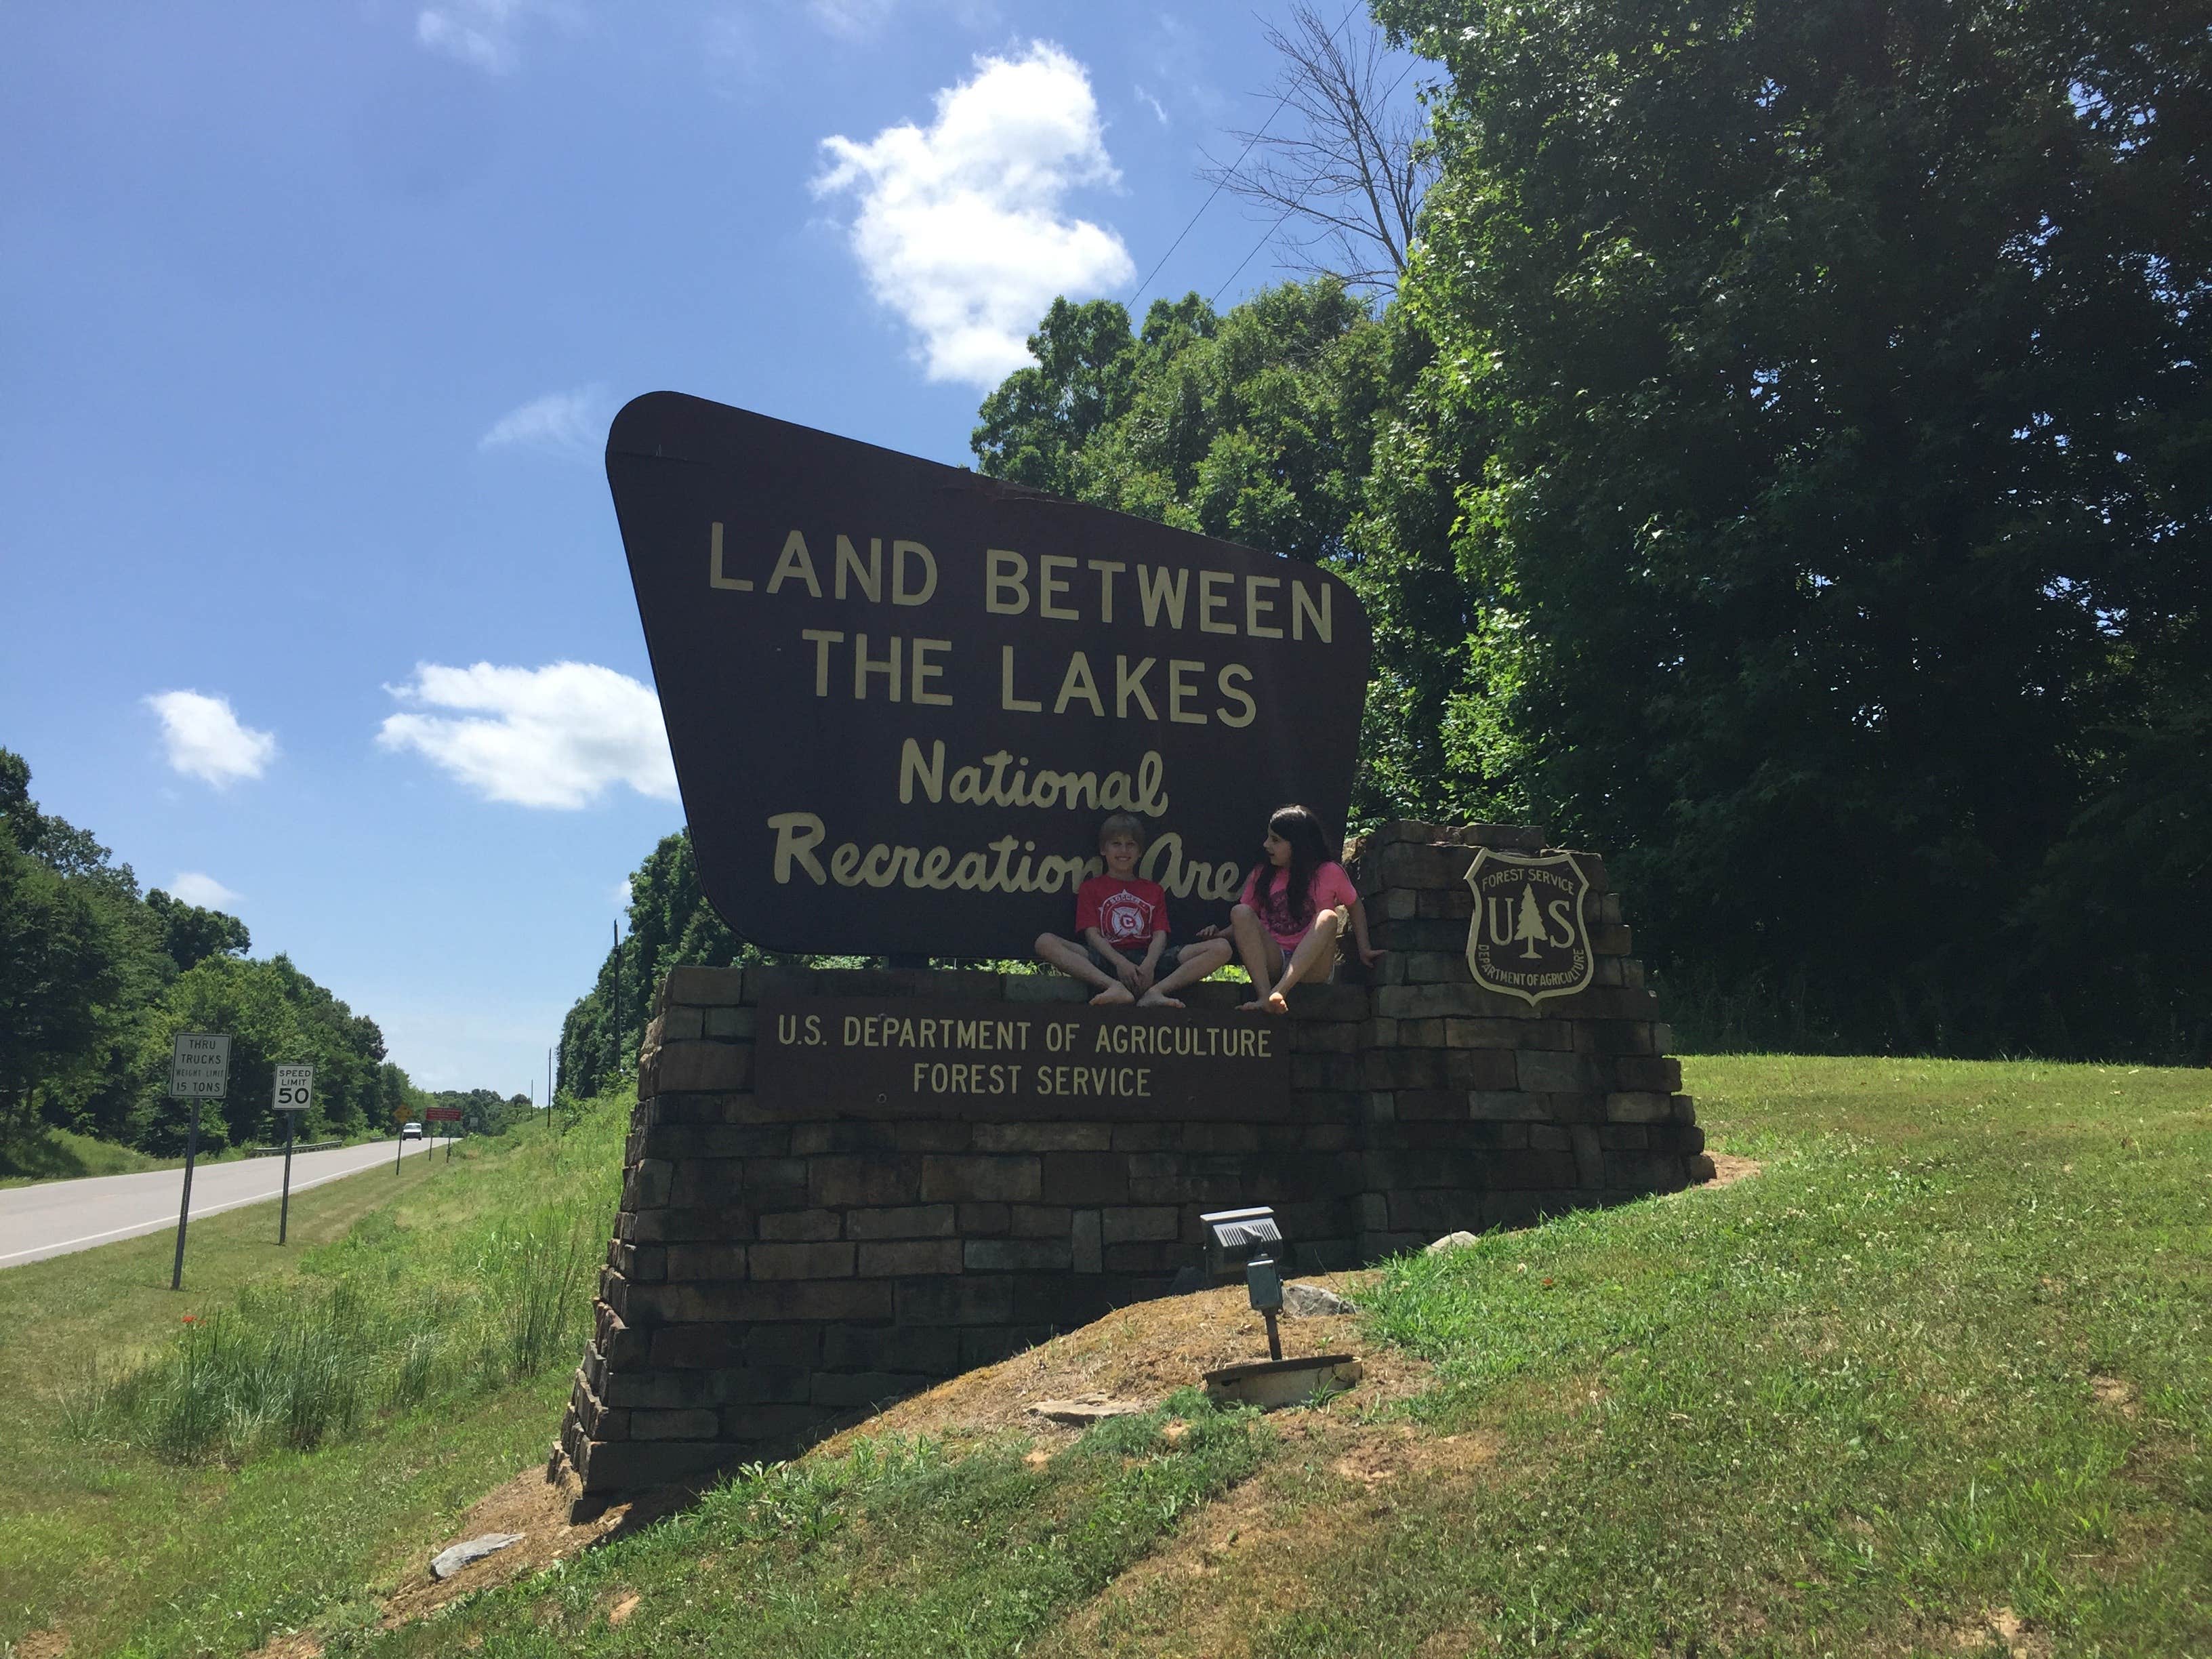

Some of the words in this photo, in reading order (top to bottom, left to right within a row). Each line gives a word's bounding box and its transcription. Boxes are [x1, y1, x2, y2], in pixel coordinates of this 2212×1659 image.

[710, 521, 938, 606] LAND
[986, 549, 1332, 643] BETWEEN
[802, 629, 954, 706] THE
[1002, 645, 1256, 728] LAKES
[899, 737, 1169, 817] National
[1139, 832, 1244, 902] Are
[1482, 868, 1525, 893] FOREST
[1528, 869, 1575, 895] SERVICE
[1478, 943, 1526, 986] DEPARTMENT
[1526, 973, 1539, 986] OF
[1539, 948, 1585, 986] AGRICULTURE
[189, 1039, 216, 1050] THRU
[778, 1014, 827, 1046] U.S.
[843, 1016, 1031, 1050] DEPARTMENT
[1045, 1022, 1080, 1052] OF
[1095, 1024, 1272, 1057] AGRICULTURE
[176, 1068, 201, 1077] WEIGHT
[206, 1069, 224, 1078] LIMIT
[181, 1054, 222, 1065] TRUCKS
[177, 1082, 187, 1091] 15
[192, 1082, 220, 1092] TONS
[279, 1069, 311, 1078] SPEED
[281, 1078, 307, 1086] LIMIT
[914, 1063, 1022, 1094] FOREST
[1036, 1065, 1151, 1097] SERVICE
[278, 1087, 310, 1105] 50
